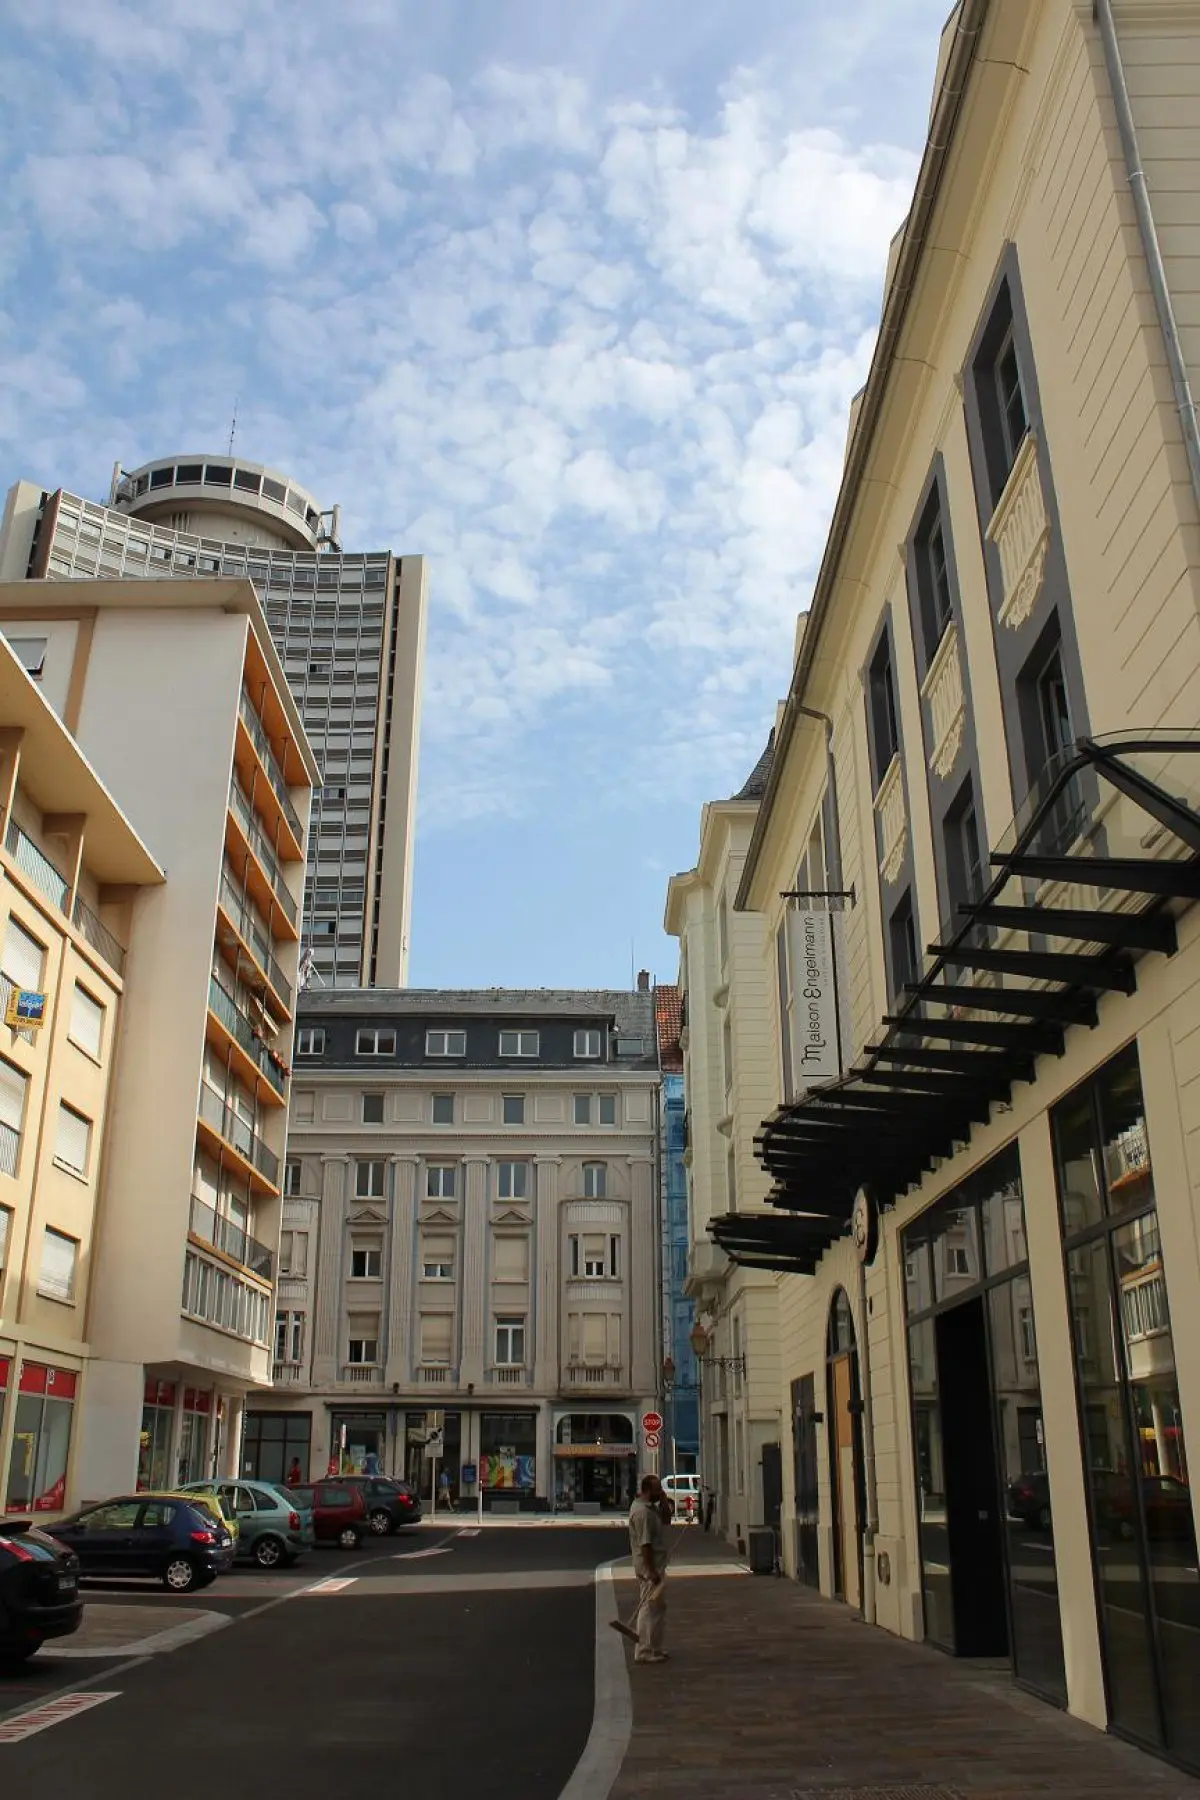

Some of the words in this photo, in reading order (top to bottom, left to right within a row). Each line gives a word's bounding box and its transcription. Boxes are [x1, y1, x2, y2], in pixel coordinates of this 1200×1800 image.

[802, 916, 822, 999] Engelmann
[801, 1002, 826, 1065] Maison
[644, 1418, 660, 1426] STOP
